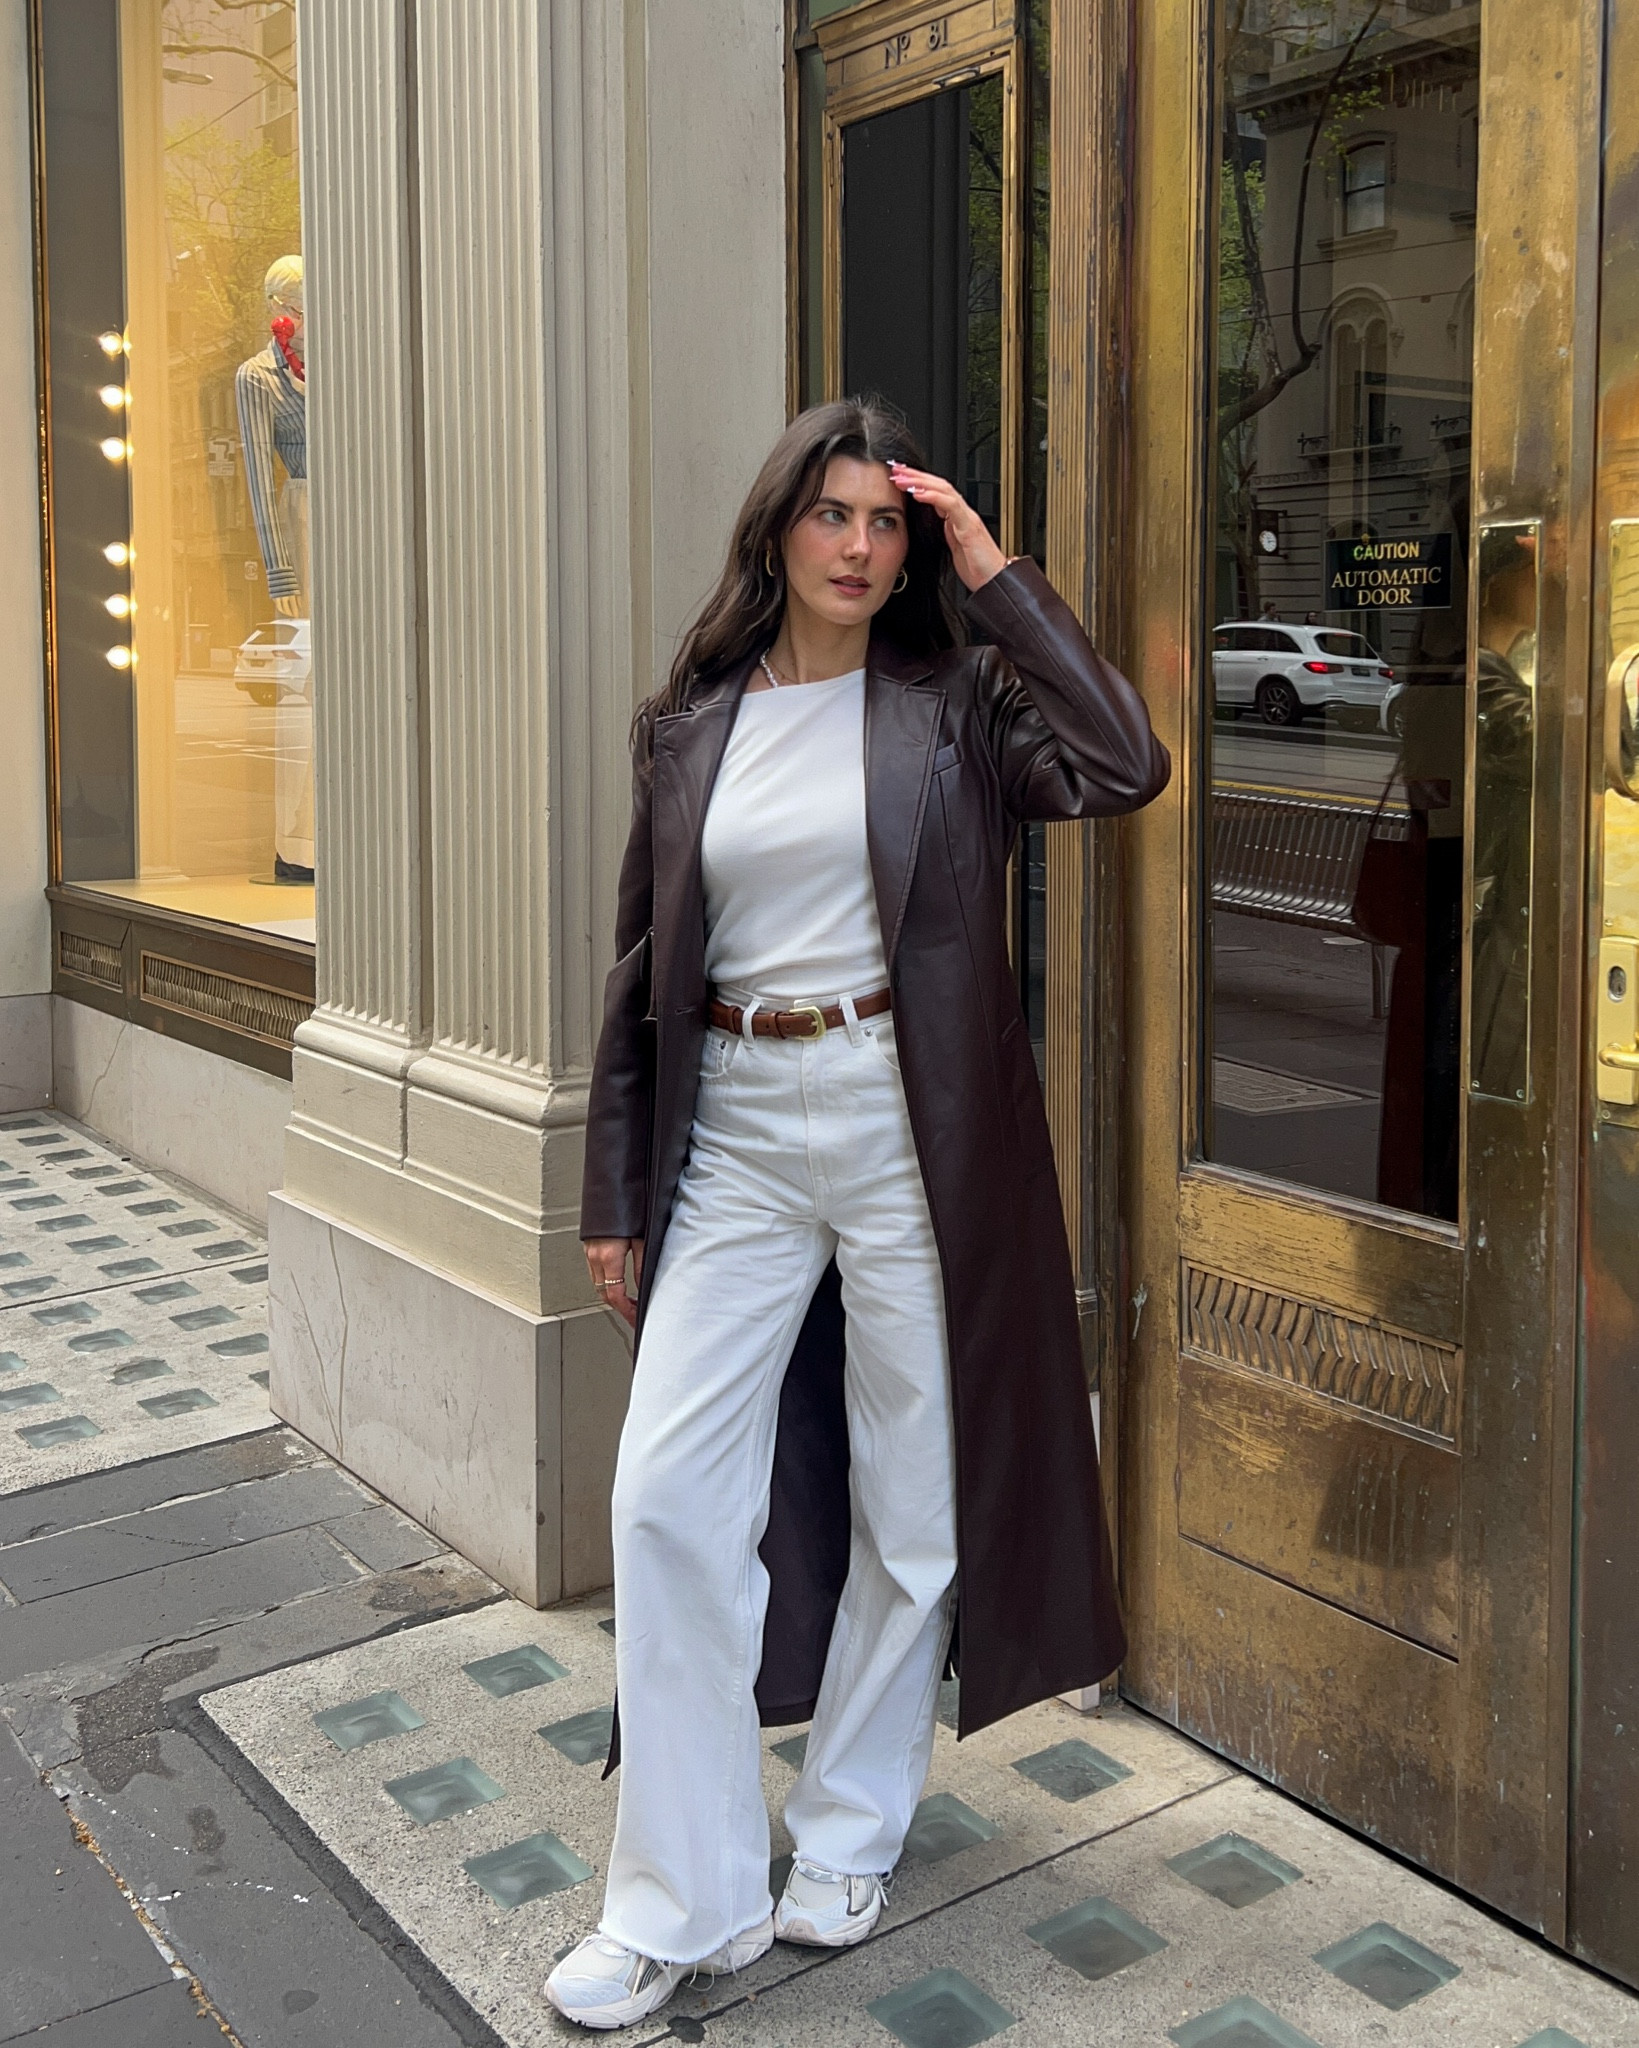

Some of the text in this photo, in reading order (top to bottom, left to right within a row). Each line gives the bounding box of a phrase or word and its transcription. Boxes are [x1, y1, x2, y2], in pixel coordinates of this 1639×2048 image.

[928, 18, 949, 52] 81
[1353, 541, 1420, 560] CAUTION
[1331, 567, 1442, 588] AUTOMATIC
[1357, 588, 1413, 606] DOOR
